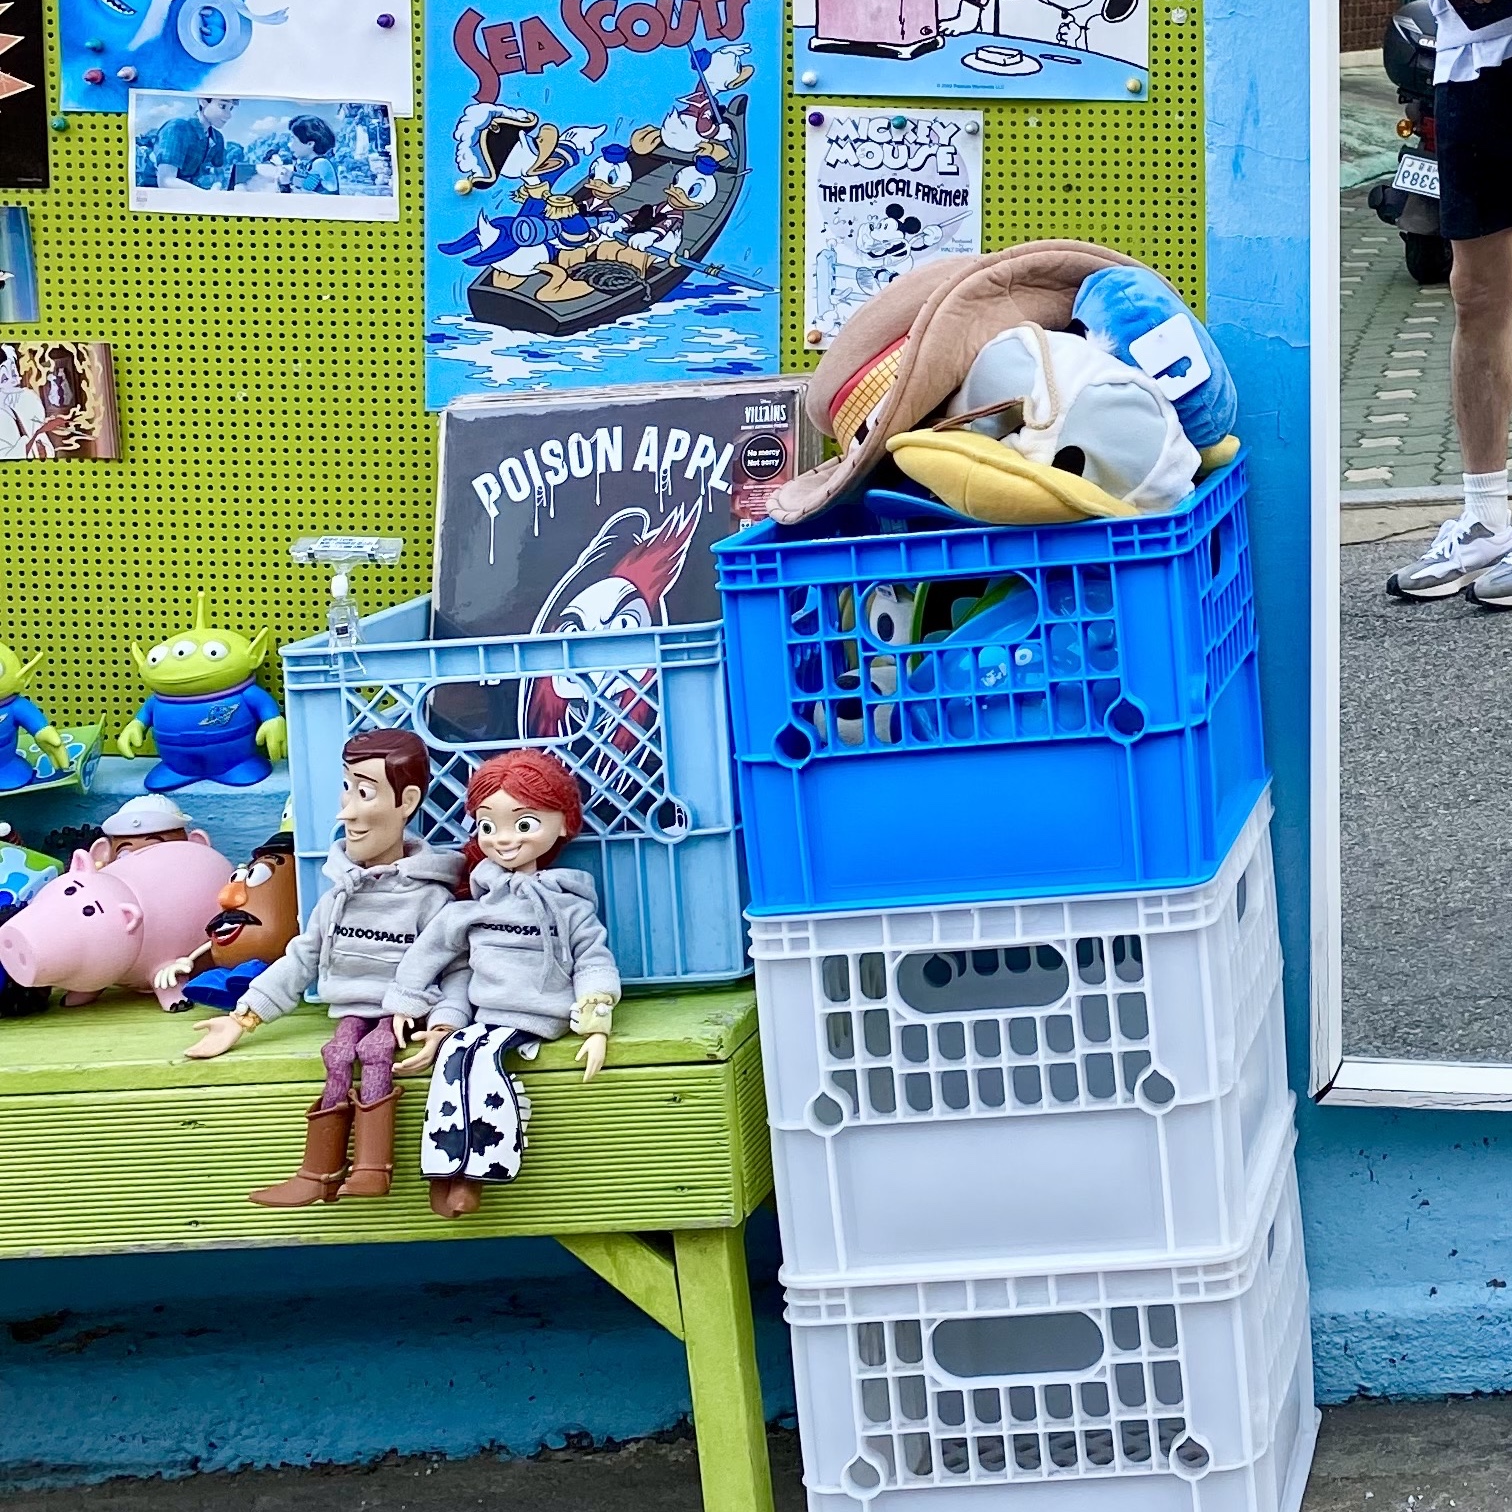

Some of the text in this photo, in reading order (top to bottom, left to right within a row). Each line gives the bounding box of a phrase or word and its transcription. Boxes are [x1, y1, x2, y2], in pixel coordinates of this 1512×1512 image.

[453, 7, 573, 105] SEA
[825, 116, 962, 147] MICKEY
[824, 139, 960, 176] MOUSE
[744, 404, 788, 424] VILLAINS
[471, 425, 733, 518] POISON APPL
